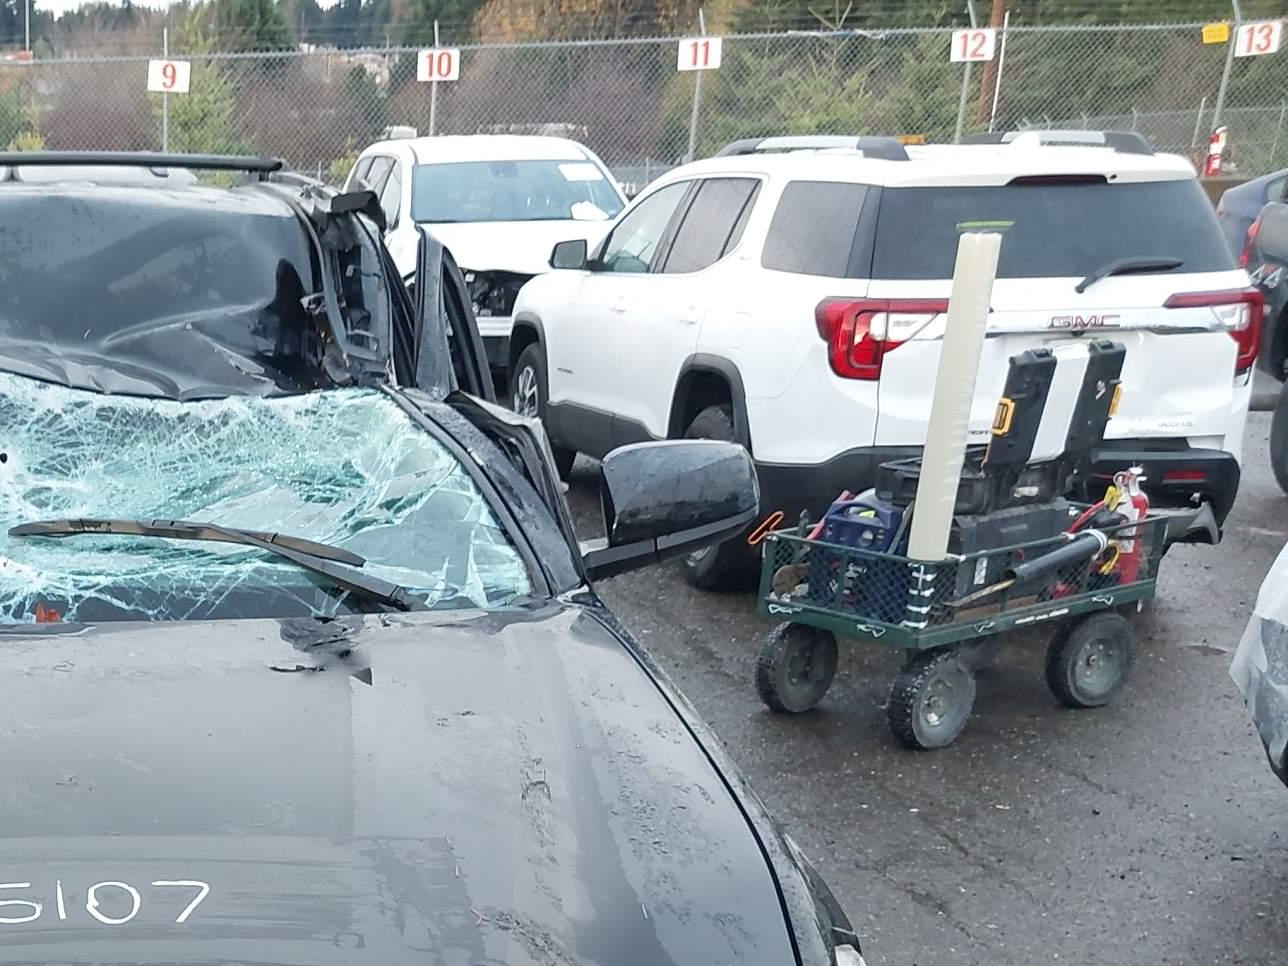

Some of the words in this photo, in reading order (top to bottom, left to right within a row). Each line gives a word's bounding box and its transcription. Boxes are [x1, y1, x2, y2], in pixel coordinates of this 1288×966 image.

[961, 33, 985, 59] 12
[1246, 24, 1273, 53] 13
[426, 51, 452, 78] 10
[690, 41, 711, 67] 11
[163, 64, 176, 88] 9
[1048, 314, 1121, 328] GMC
